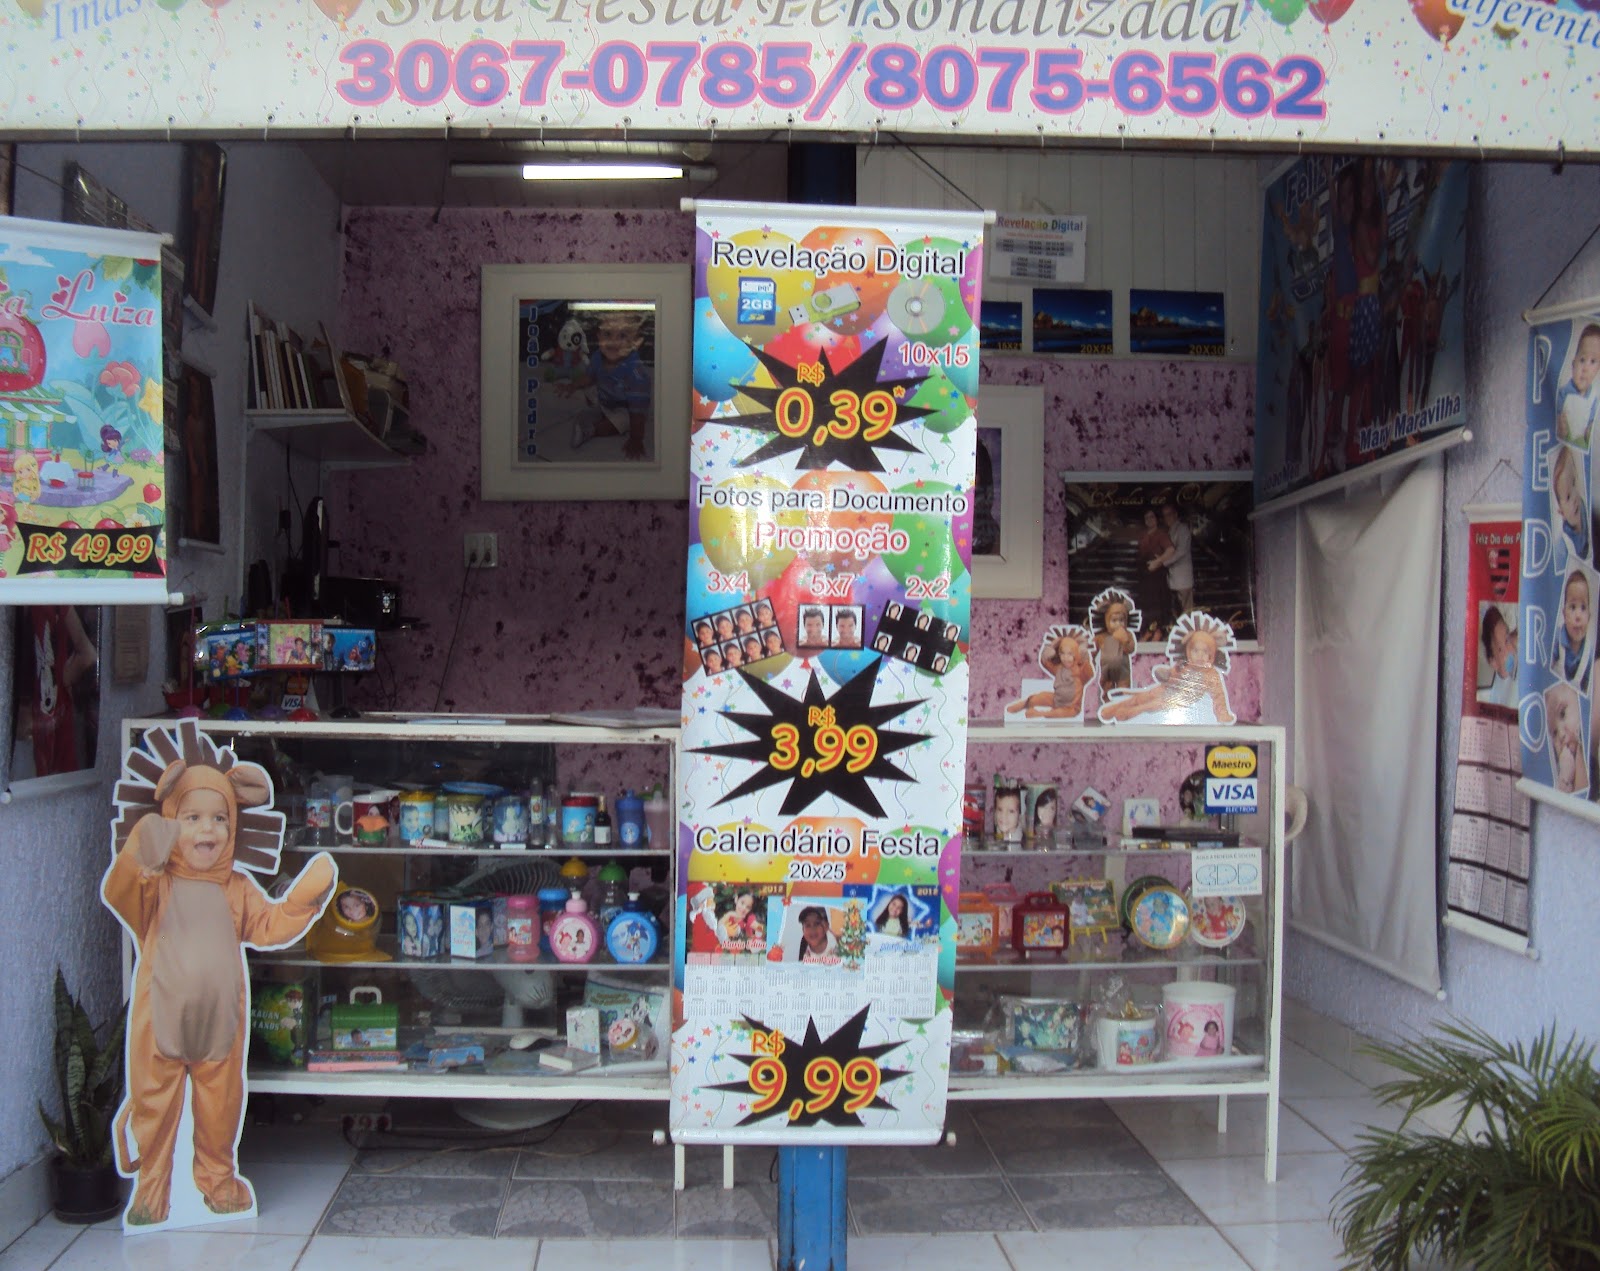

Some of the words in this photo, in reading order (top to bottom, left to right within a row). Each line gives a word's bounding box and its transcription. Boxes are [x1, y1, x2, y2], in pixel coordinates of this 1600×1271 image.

[336, 39, 1327, 121] 3067-0785/8075-6562
[713, 241, 866, 276] Revelação
[875, 246, 967, 278] Digital
[41, 269, 155, 327] Luiza
[741, 298, 773, 310] 2GB
[897, 343, 970, 367] 10x15
[796, 361, 826, 386] R$
[1359, 424, 1391, 453] Mary
[1393, 393, 1461, 440] Maravilha
[699, 484, 764, 506] Fotos
[771, 489, 823, 511] para
[833, 490, 968, 514] Documento
[27, 534, 66, 564] R$
[72, 534, 153, 567] 49,99
[756, 522, 908, 557] Promoção
[707, 571, 749, 593] 3x4
[810, 574, 854, 596] 5x7
[906, 577, 949, 599] 2x2
[808, 705, 836, 728] R$
[768, 723, 879, 778] 3,99
[1212, 760, 1252, 769] Maestro
[1212, 784, 1255, 800] VISA
[695, 826, 852, 853] Calendário
[861, 829, 940, 857] Festa
[789, 862, 845, 881] 20x25
[751, 1030, 785, 1056] R$
[749, 1057, 881, 1119] 9,99
